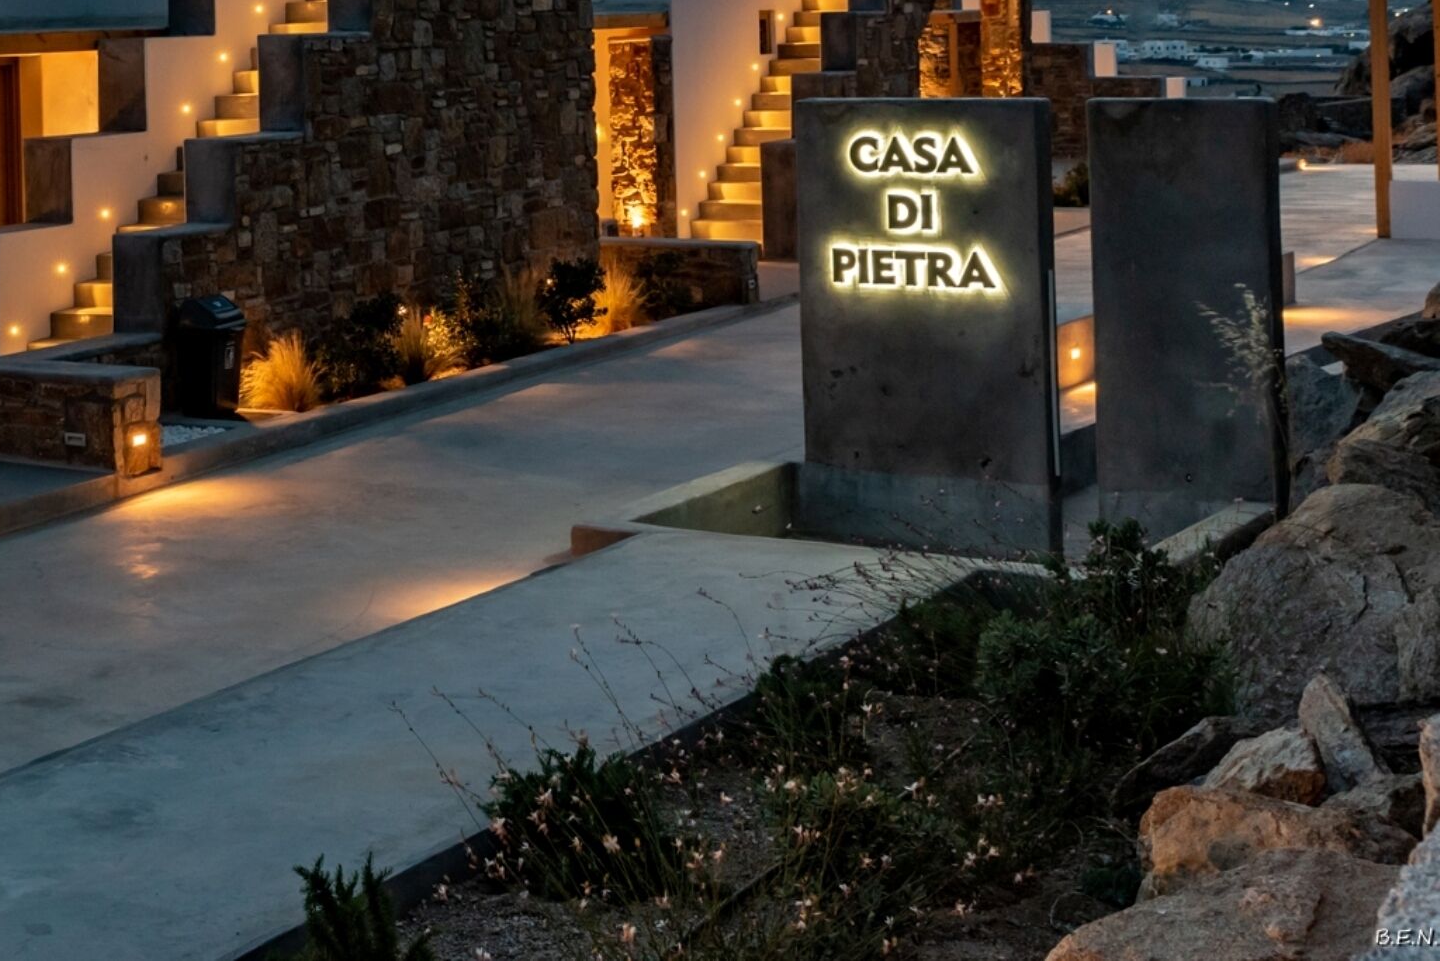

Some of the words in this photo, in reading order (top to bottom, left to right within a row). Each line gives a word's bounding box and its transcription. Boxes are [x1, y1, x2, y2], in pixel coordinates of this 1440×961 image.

[849, 136, 974, 174] CASA
[887, 194, 933, 230] DI
[832, 248, 996, 288] PIETRA
